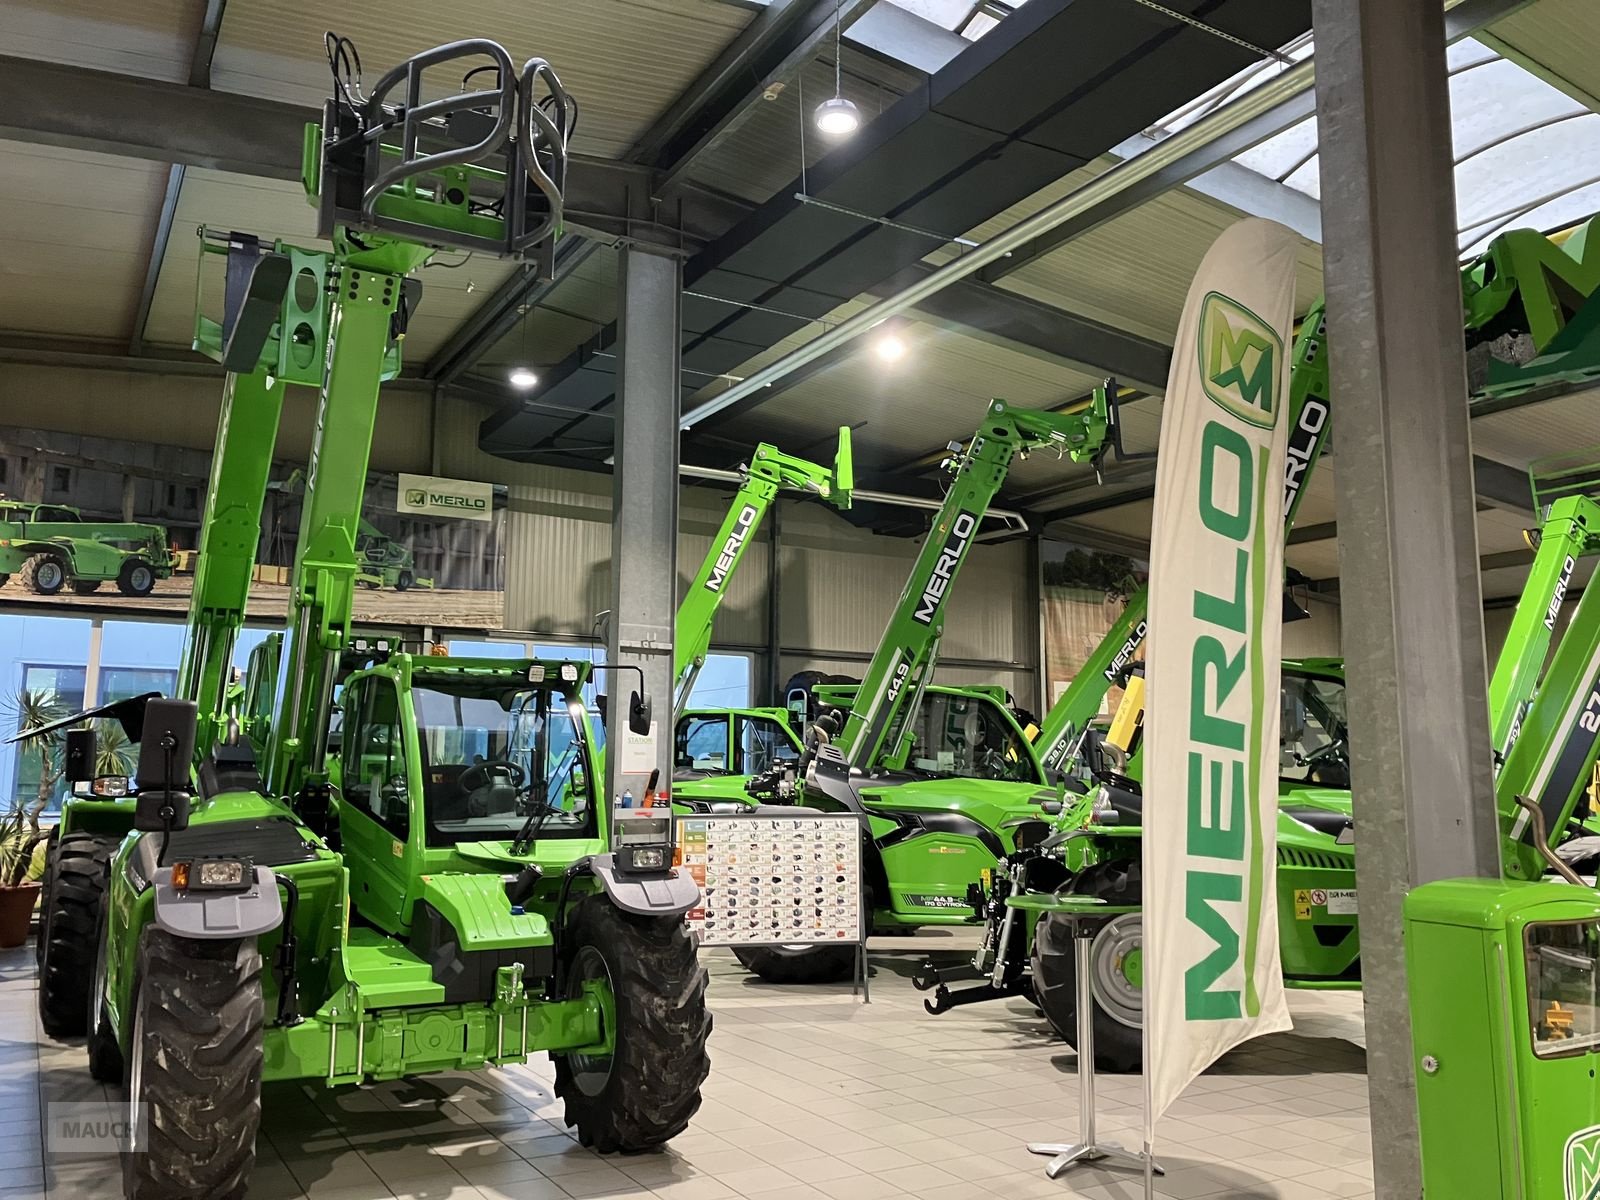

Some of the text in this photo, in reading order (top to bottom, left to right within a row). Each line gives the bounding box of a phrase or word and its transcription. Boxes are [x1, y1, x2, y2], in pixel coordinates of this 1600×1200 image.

[1283, 400, 1328, 518] RLO
[430, 494, 486, 508] MERLO
[705, 506, 756, 590] MERLO
[914, 513, 975, 623] MERLO
[1544, 555, 1575, 631] MERLO
[887, 663, 909, 702] 44.9
[1104, 621, 1147, 680] MERLO
[1047, 739, 1067, 765] 38.10
[1185, 419, 1254, 1022] MERLO
